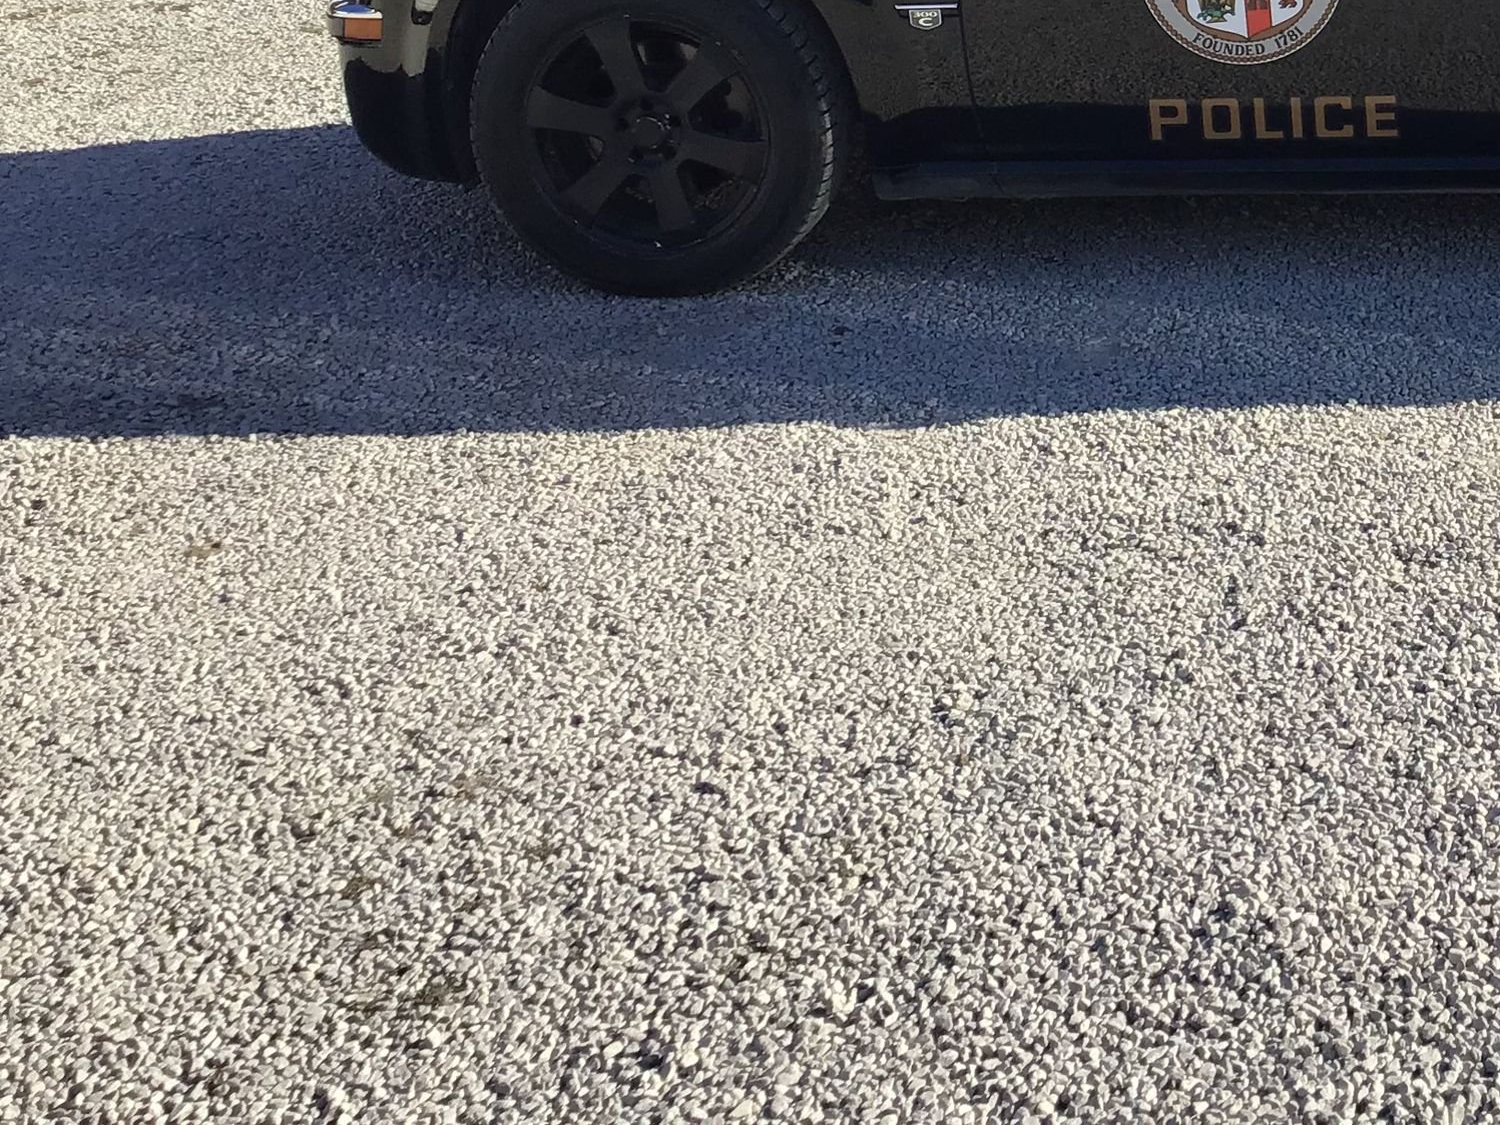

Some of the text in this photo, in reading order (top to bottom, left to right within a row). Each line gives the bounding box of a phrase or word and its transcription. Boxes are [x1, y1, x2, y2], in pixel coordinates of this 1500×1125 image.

[918, 17, 933, 27] C
[1192, 26, 1305, 56] FOUNDED 1781
[1148, 95, 1398, 141] POLICE
